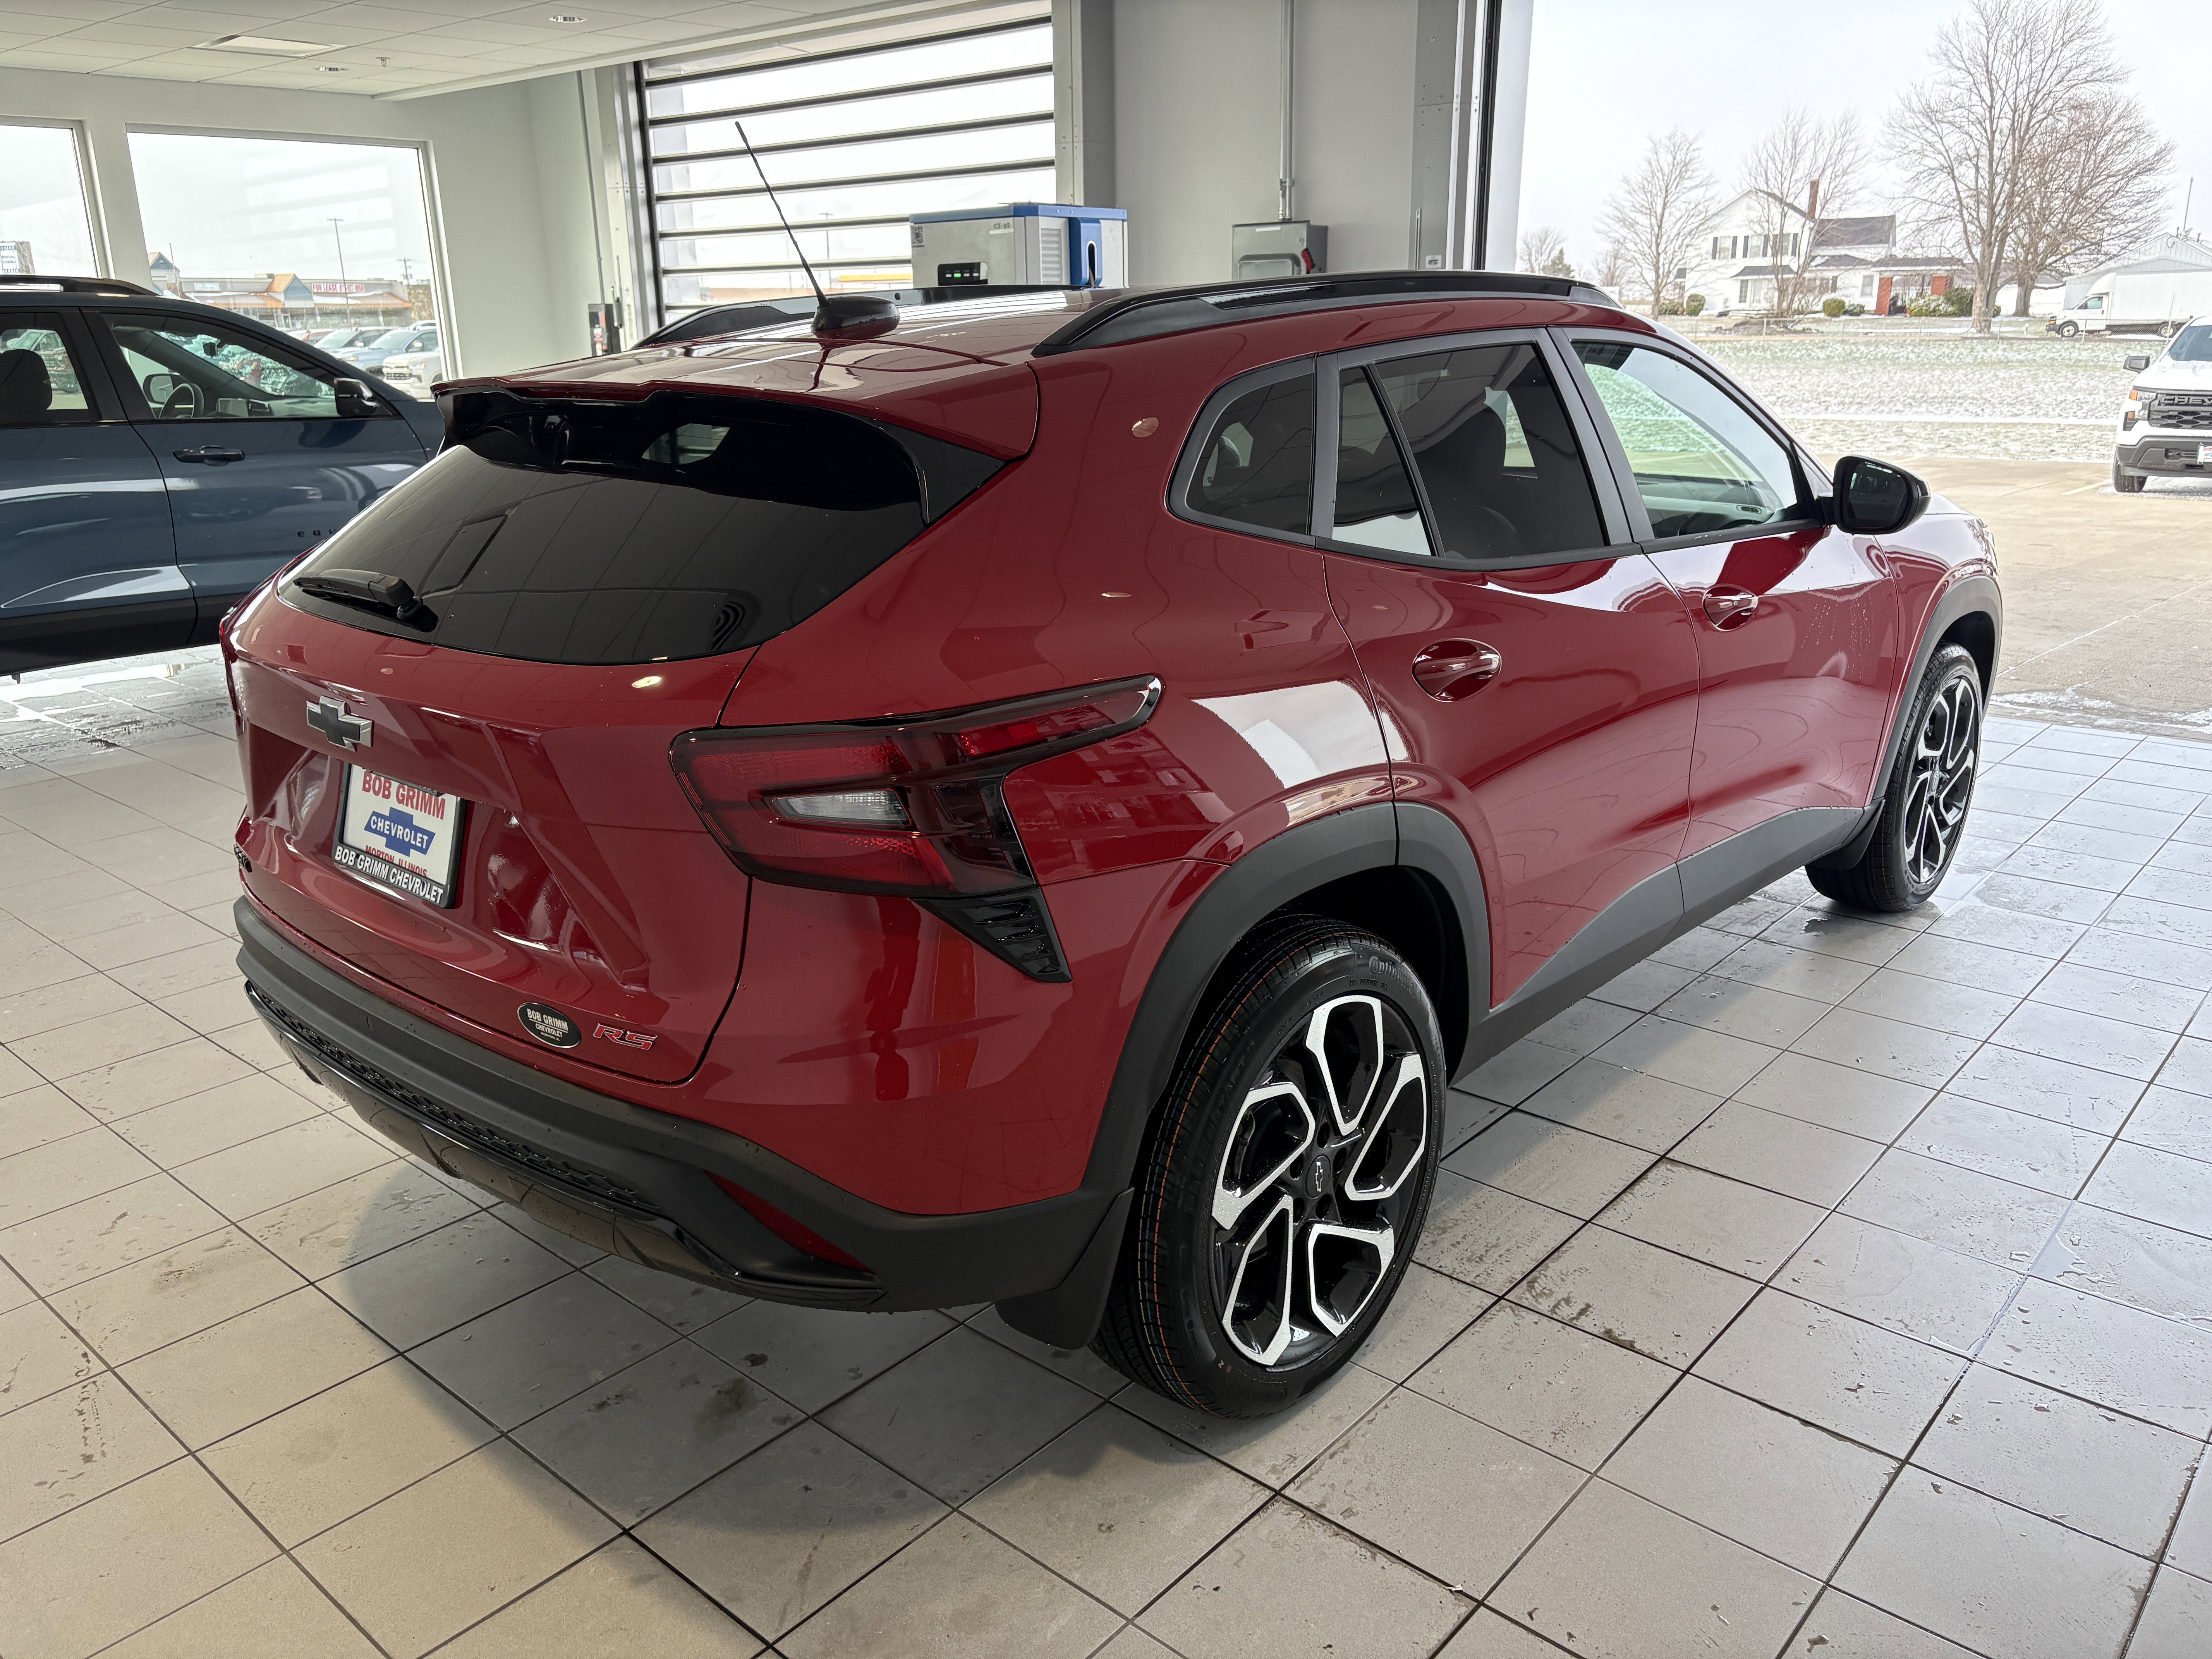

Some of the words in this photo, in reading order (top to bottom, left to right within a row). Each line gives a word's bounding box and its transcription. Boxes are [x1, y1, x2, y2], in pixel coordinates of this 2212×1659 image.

[362, 771, 392, 799] BOB
[396, 784, 446, 820] GRIMM
[371, 816, 428, 849] CHEVROLET
[335, 845, 356, 866] BOB
[357, 854, 390, 880] GRIMM
[390, 867, 444, 904] CHEVROLET
[527, 1008, 542, 1022] BOB
[543, 1014, 568, 1031] GRIMM
[535, 1023, 563, 1038] CHEVROLET
[593, 1023, 658, 1050] RS
